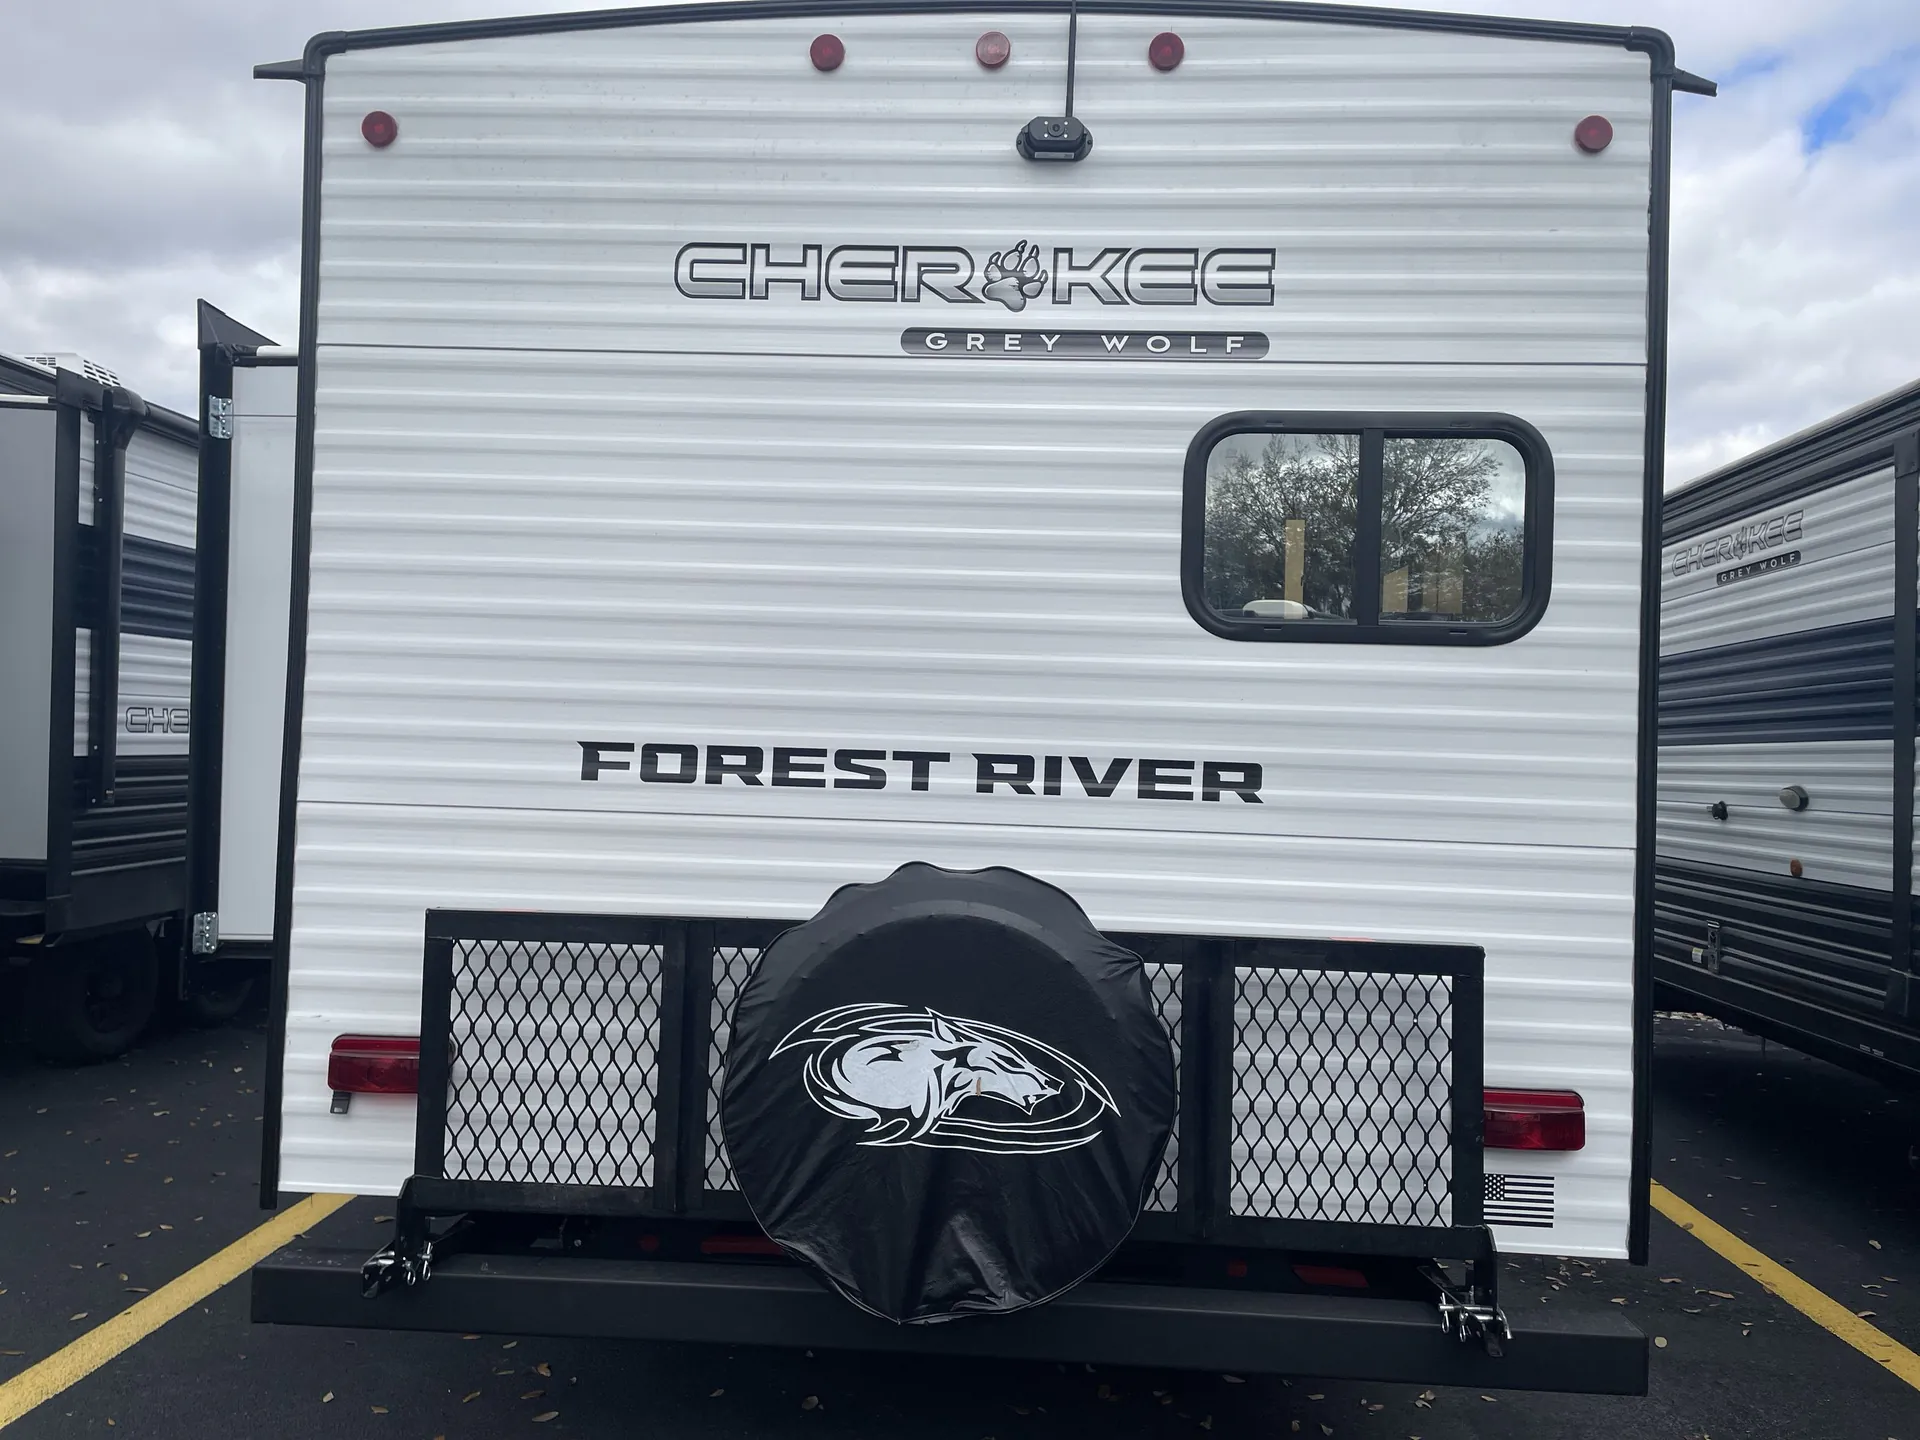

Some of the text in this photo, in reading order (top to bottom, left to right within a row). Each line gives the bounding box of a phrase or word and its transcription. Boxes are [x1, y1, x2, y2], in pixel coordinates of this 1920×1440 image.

[925, 331, 1246, 355] GREY WOLF
[1721, 553, 1796, 582] GREY WOLF
[577, 741, 1264, 804] FOREST RIVER
